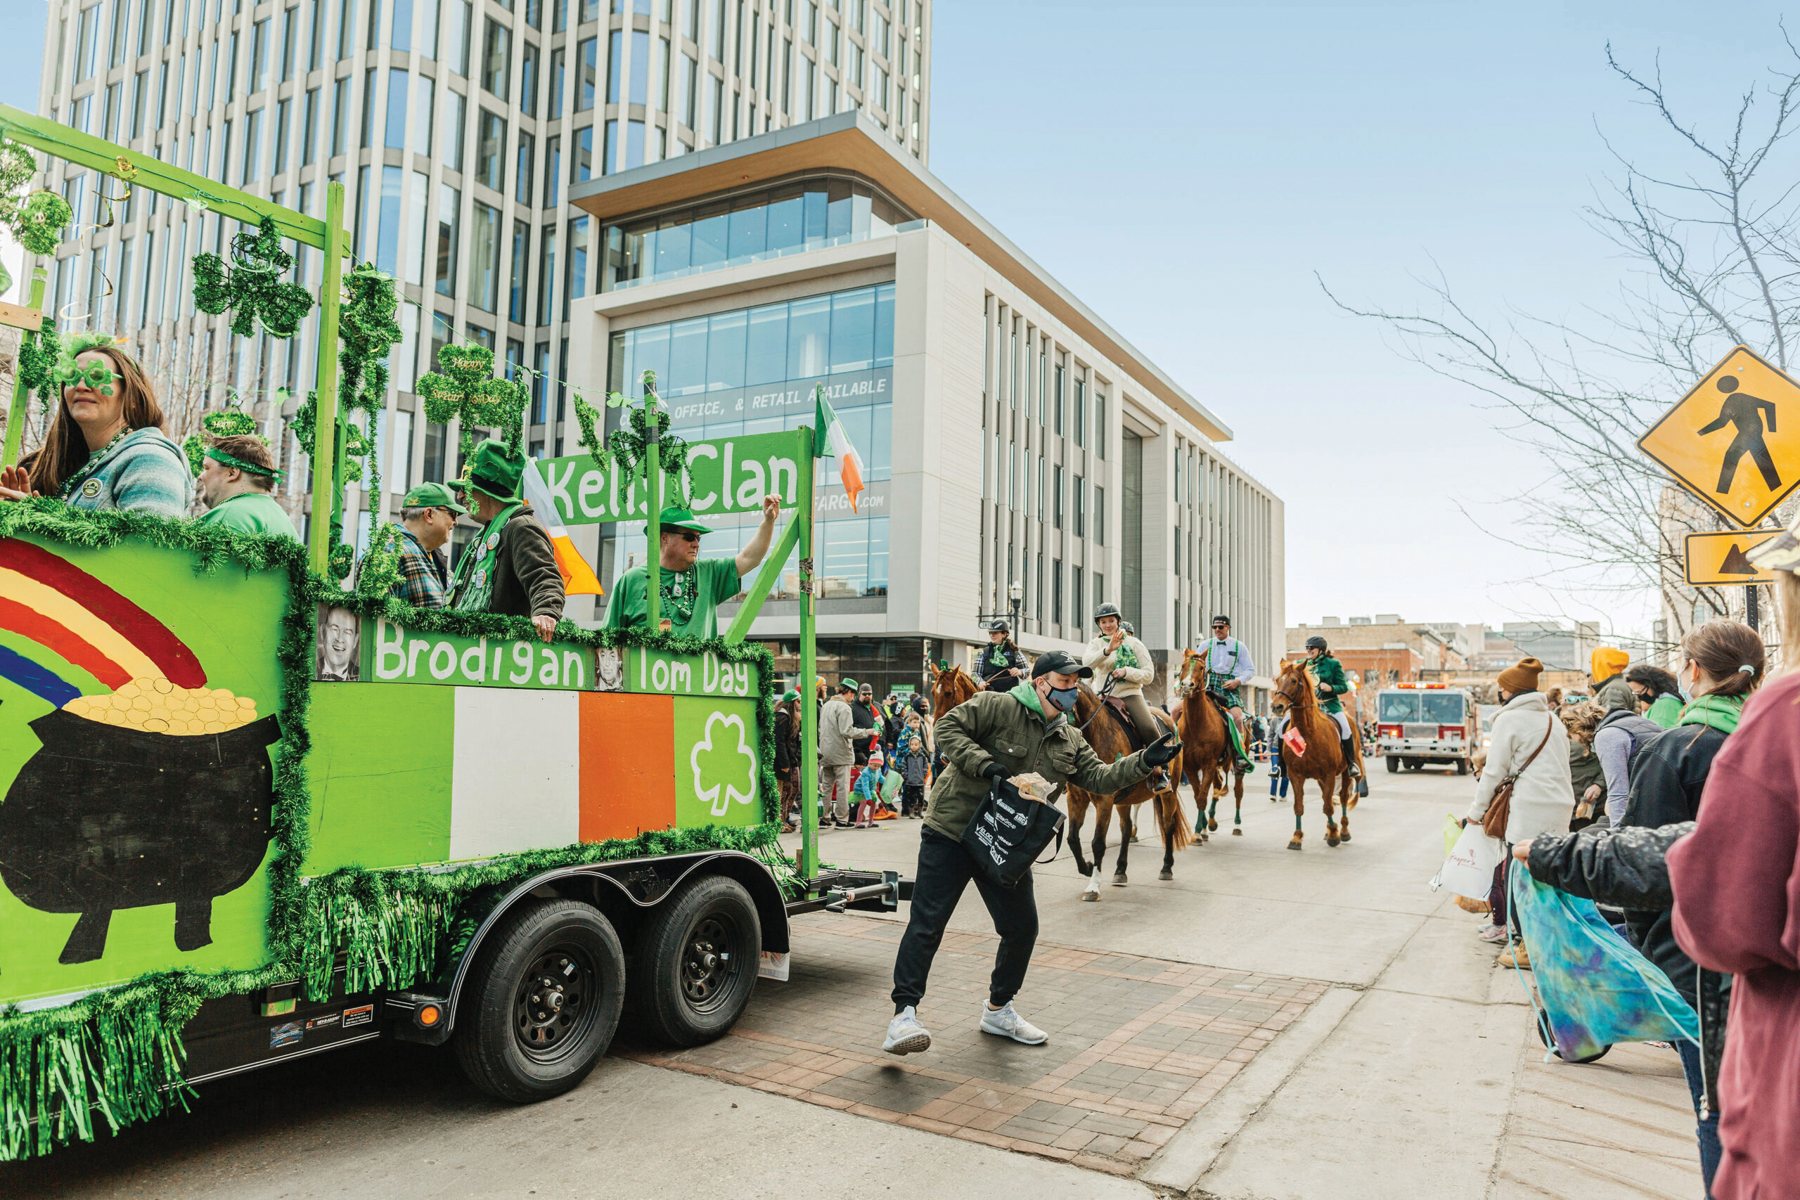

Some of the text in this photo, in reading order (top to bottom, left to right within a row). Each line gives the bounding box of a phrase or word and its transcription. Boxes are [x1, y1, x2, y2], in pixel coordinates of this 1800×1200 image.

[674, 401, 725, 419] OFFICE,
[735, 398, 744, 411] &
[752, 390, 802, 408] RETAIL
[681, 442, 798, 510] Clan
[375, 619, 584, 688] Brodigan
[703, 651, 748, 697] Day
